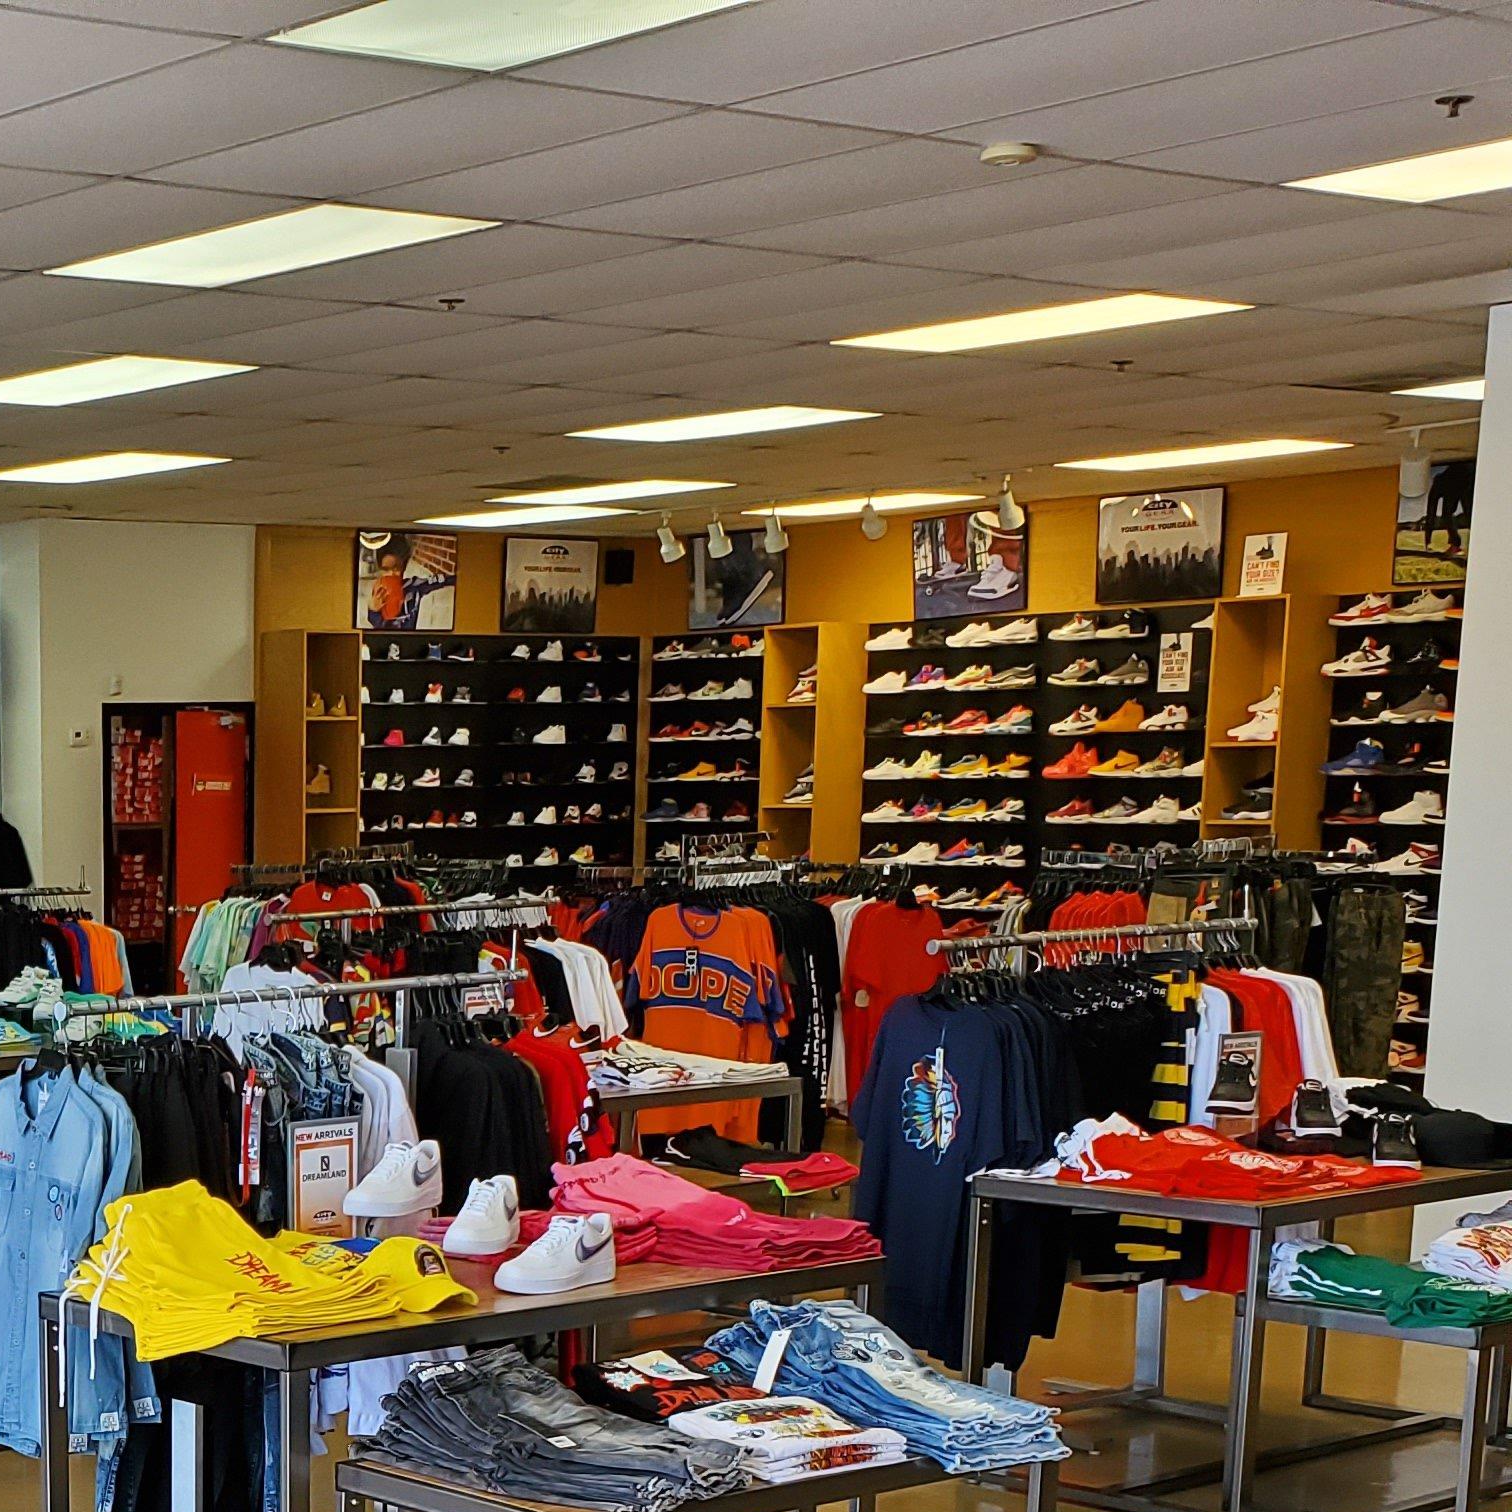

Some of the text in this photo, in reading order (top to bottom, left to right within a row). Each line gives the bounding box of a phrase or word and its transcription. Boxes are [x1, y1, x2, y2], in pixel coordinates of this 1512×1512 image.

[296, 1127, 354, 1142] NEW ARRIVALS
[302, 1169, 347, 1183] DREAMLAND
